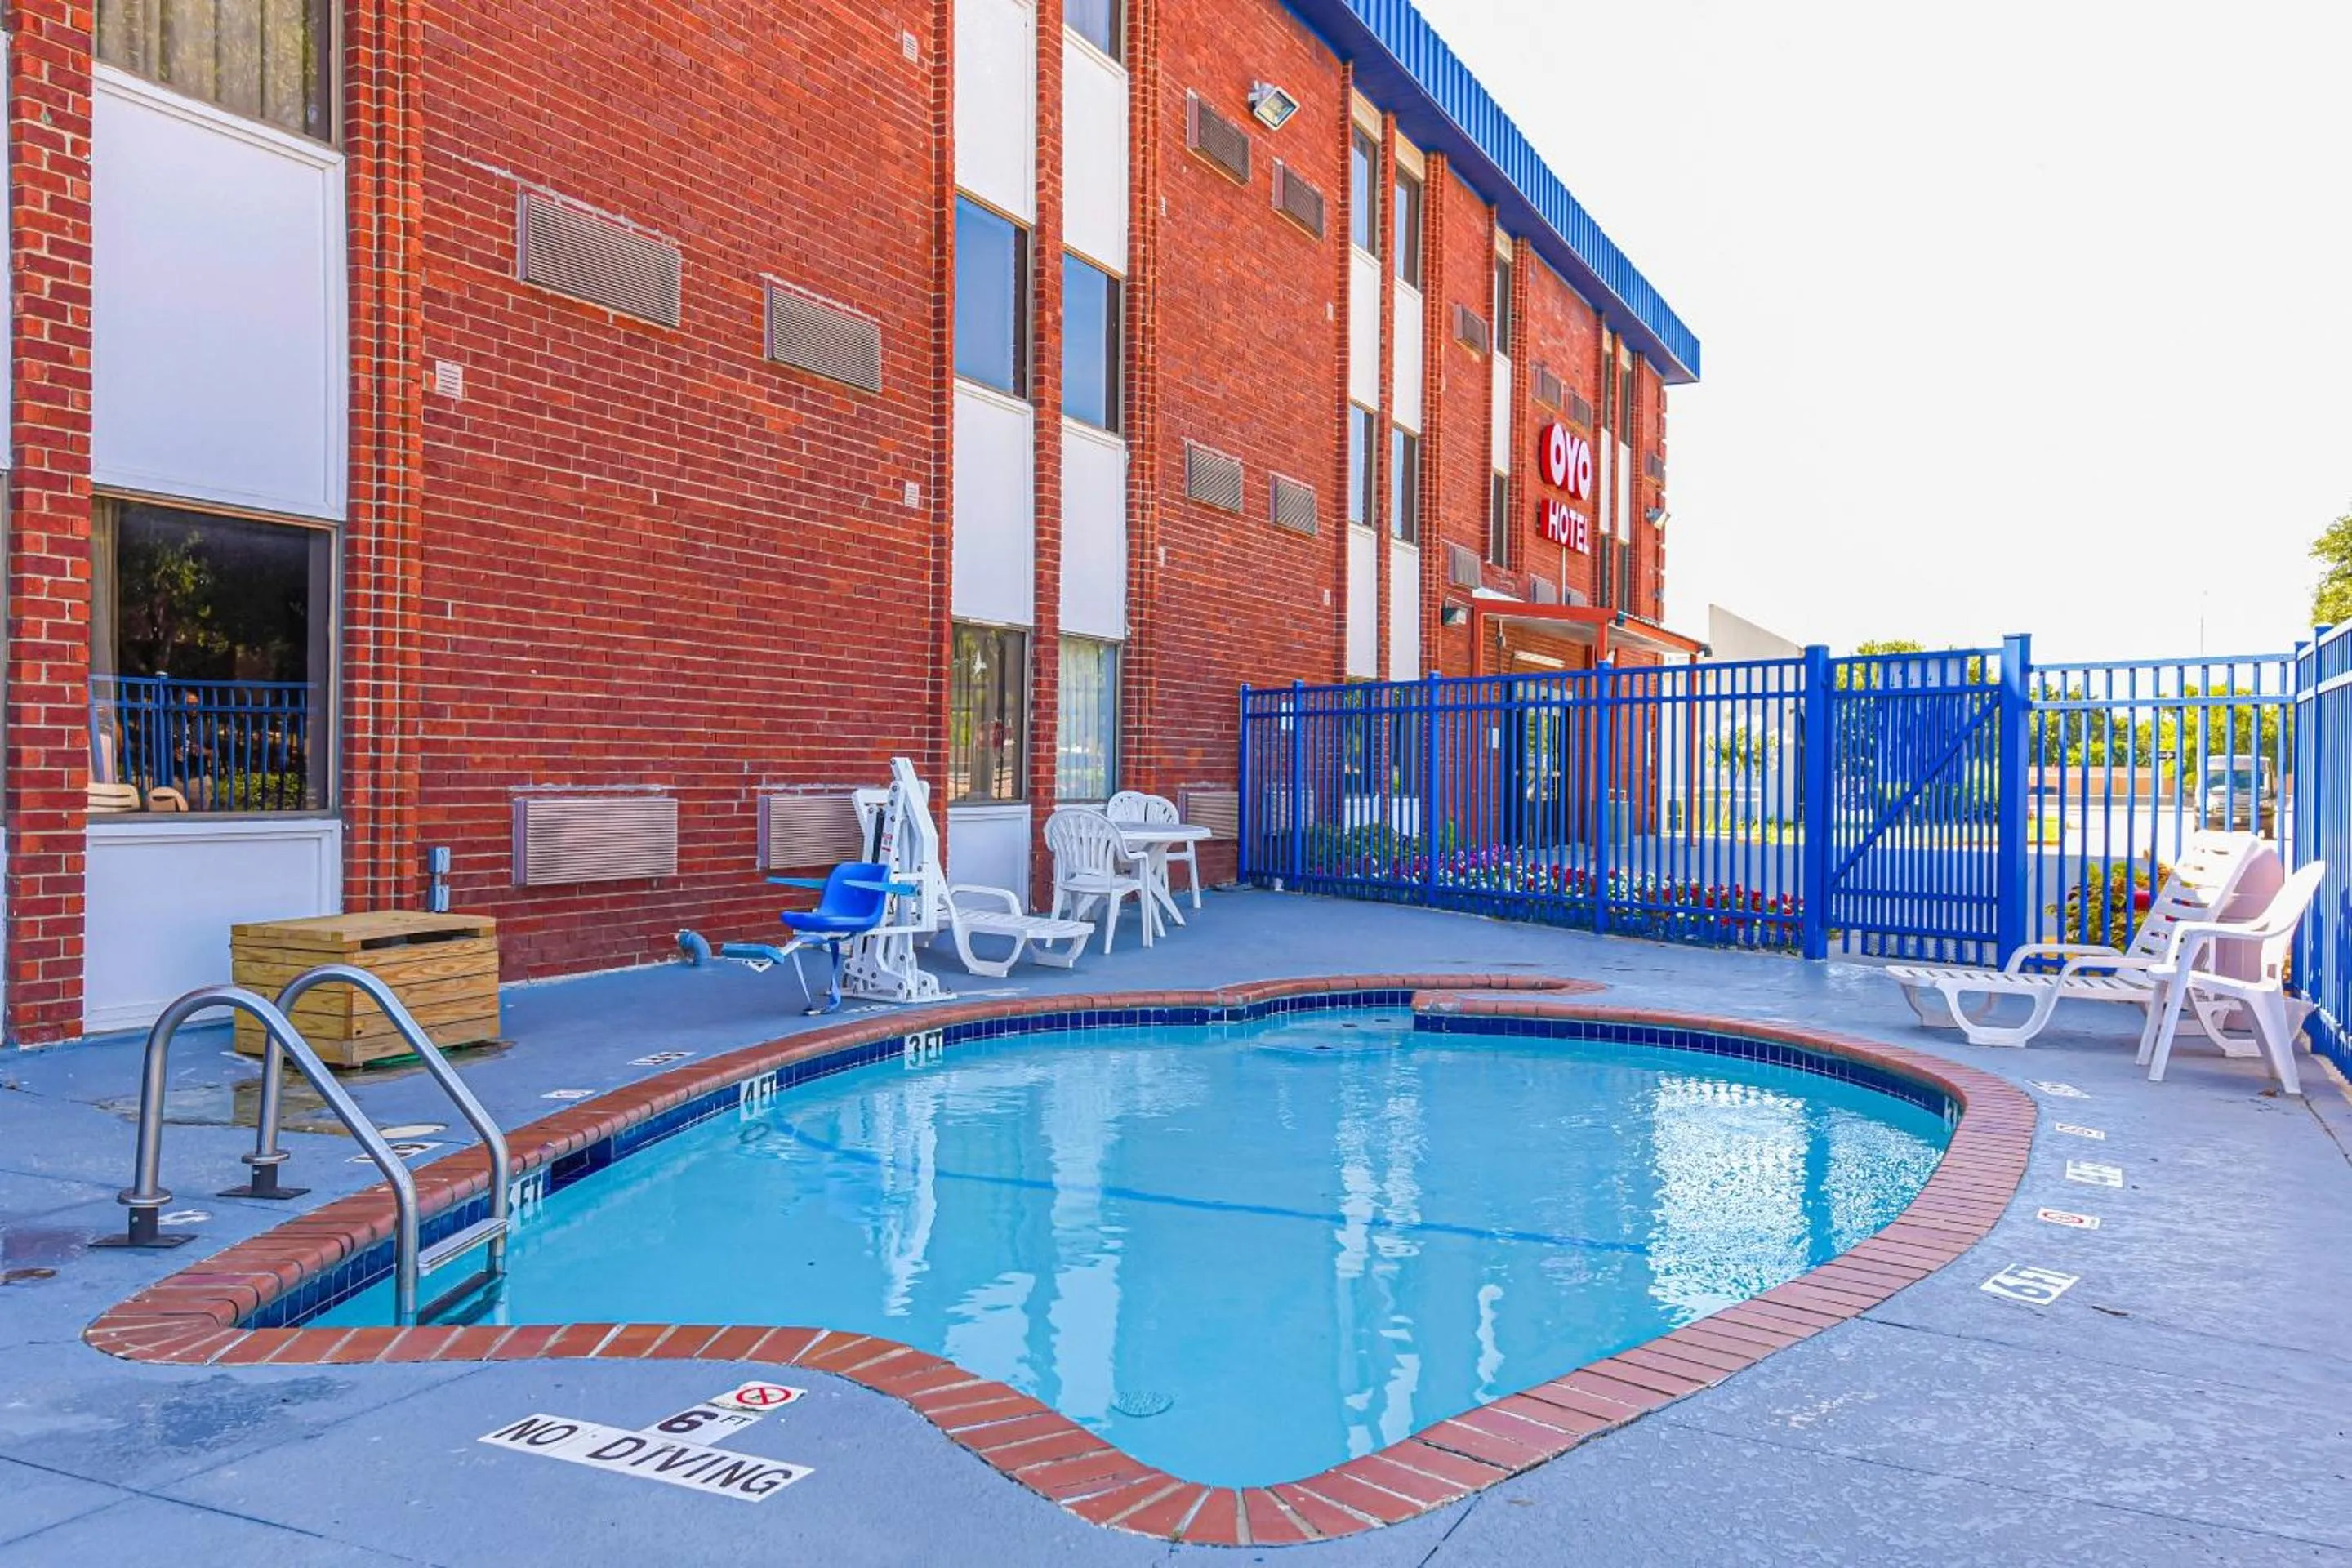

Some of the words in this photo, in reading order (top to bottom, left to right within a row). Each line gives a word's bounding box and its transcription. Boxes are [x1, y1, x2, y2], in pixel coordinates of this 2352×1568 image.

[1550, 423, 1592, 501] OYO
[1548, 498, 1591, 556] HOTEL
[924, 1030, 942, 1051] FT
[760, 1074, 775, 1098] FT
[657, 1410, 719, 1435] 6
[718, 1414, 753, 1426] FT
[491, 1417, 579, 1446] NO
[586, 1435, 793, 1495] DIVING
